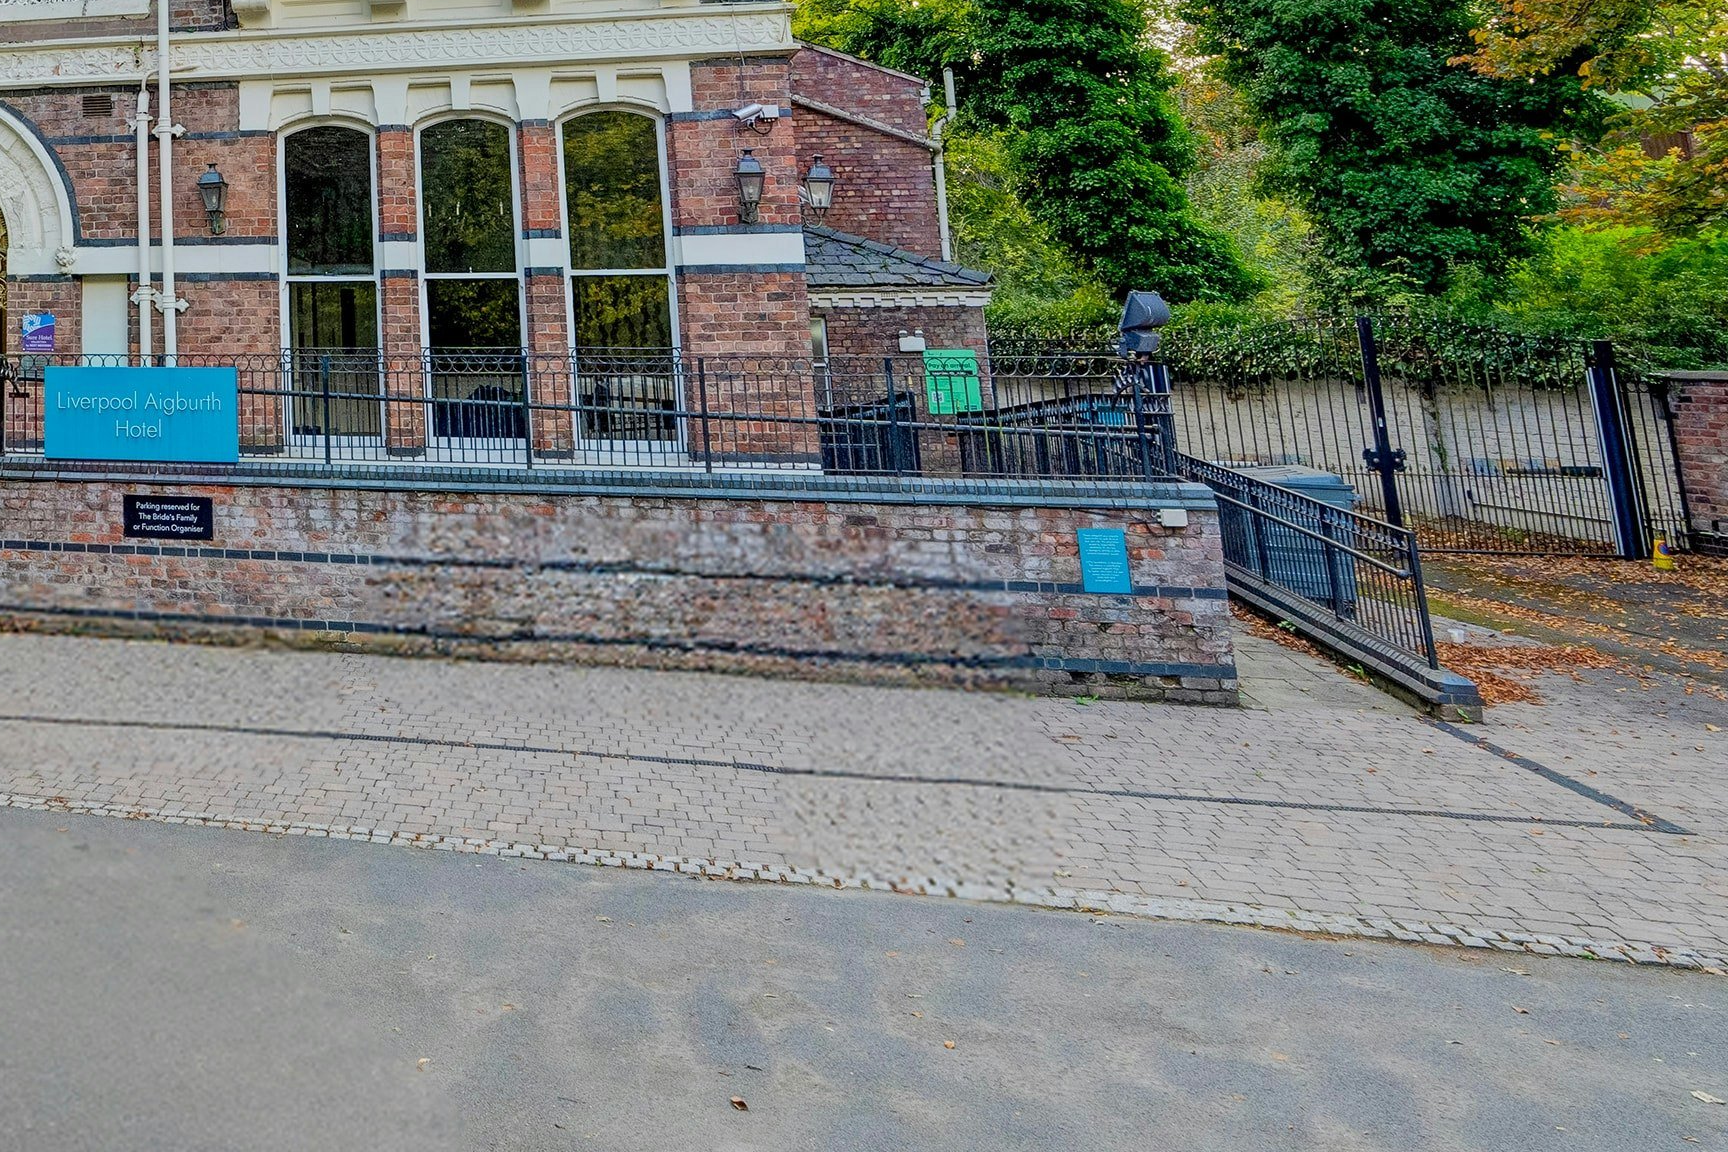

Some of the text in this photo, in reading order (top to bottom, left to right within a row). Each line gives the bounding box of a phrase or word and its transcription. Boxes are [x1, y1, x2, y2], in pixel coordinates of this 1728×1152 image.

[57, 390, 222, 416] Liverpool Aigburth
[115, 418, 162, 438] Hotel
[135, 501, 201, 512] Parking reserved for
[138, 512, 198, 524] The Bride's Family
[141, 523, 170, 531] Function
[170, 524, 204, 534] Organiser
